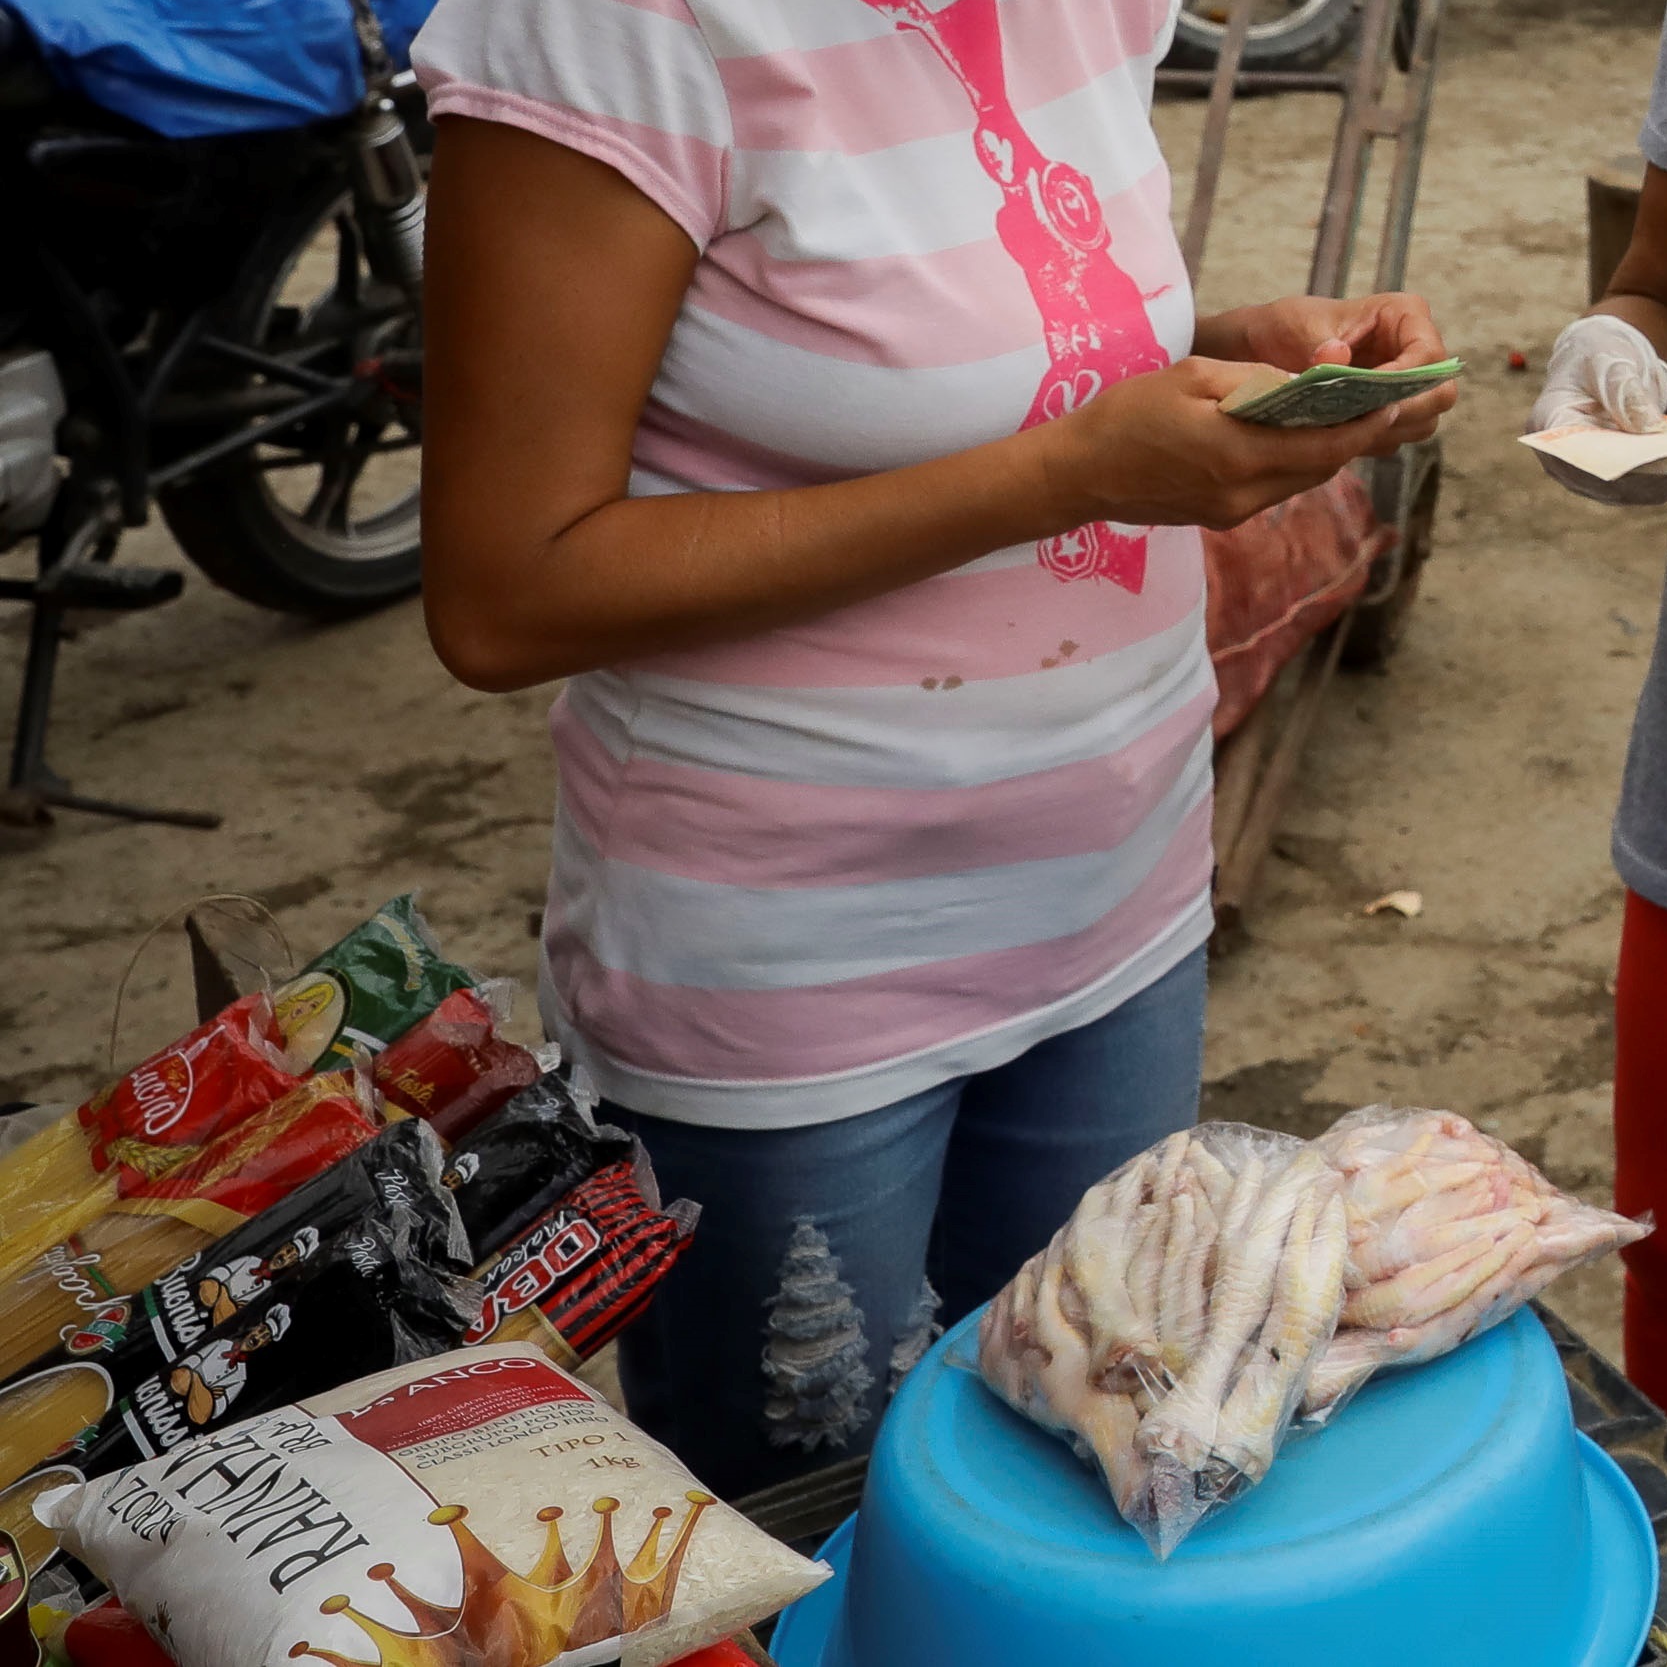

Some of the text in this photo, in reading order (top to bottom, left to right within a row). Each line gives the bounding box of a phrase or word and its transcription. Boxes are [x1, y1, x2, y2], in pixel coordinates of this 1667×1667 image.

[373, 1168, 414, 1207] Past
[152, 1251, 208, 1351] Buonis
[268, 1420, 333, 1455] BRA
[397, 1432, 467, 1458] GRUPO
[472, 1401, 596, 1436] BENEFICIADO
[414, 1425, 519, 1462] SUBGRUPO
[524, 1407, 596, 1428] POLIDO
[415, 1414, 610, 1471] CLASSE LONGO FINO
[529, 1430, 631, 1460] TIPO 1
[585, 1453, 642, 1472] 1kg
[106, 1476, 189, 1547] ARROZ
[160, 1434, 370, 1595] RAINHA
